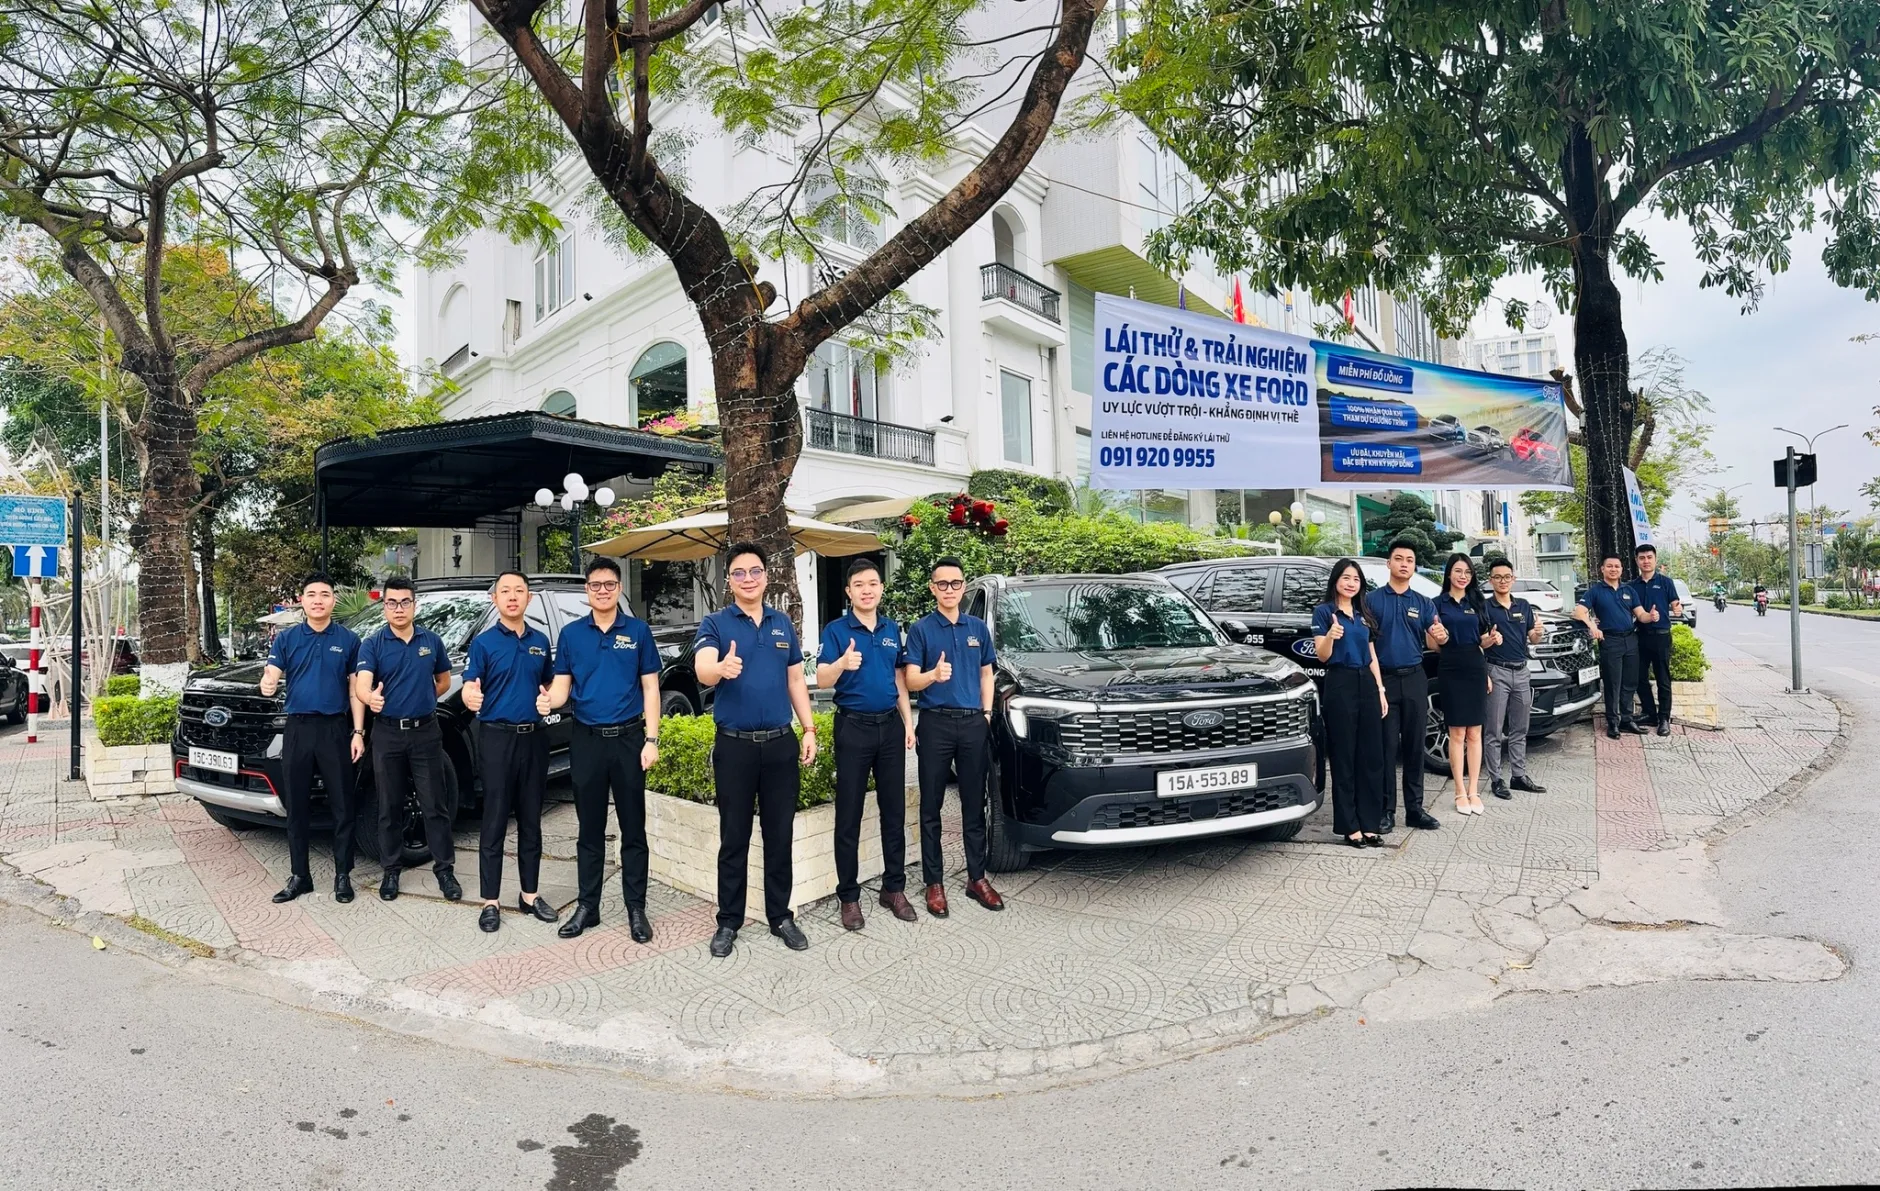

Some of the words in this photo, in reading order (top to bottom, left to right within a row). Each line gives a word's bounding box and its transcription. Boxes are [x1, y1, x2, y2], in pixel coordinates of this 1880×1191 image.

[1105, 323, 1137, 354] LÁI
[1140, 326, 1183, 358] THỬ
[1184, 337, 1199, 361] &
[1202, 334, 1242, 366] TRẢI
[1246, 346, 1307, 377] NGHIỆM
[1338, 362, 1358, 378] MIỄN
[1359, 368, 1372, 380] PHÍ
[1104, 355, 1150, 394] CÁC
[1155, 360, 1220, 398] DÒNG
[1224, 372, 1252, 402] XE
[1256, 376, 1308, 406] FORD
[1102, 401, 1119, 413] UY
[1121, 400, 1142, 417] LỰC
[1144, 401, 1175, 418] VƯỢT
[1177, 403, 1201, 419] TRỘI
[1209, 402, 1244, 420] KHẲNG
[1245, 409, 1269, 422] ĐỊNH
[1270, 411, 1280, 424] VỊ
[1342, 414, 1360, 422] THAM
[1101, 429, 1118, 439] LIÊN
[1119, 430, 1129, 441] HỆ
[1130, 431, 1162, 440] HOTLINE
[1163, 428, 1172, 441] ĐỂ
[1173, 431, 1193, 441] ĐĂNG
[1194, 432, 1203, 442] KÝ
[1204, 432, 1215, 442] LÁI
[1100, 446, 1132, 467] 091
[1136, 446, 1169, 467] 920
[1173, 447, 1215, 467] 9955
[771, 629, 784, 637] Ford
[329, 645, 343, 653] Ford
[613, 640, 637, 649] Ford
[882, 637, 898, 648] Ford
[1191, 713, 1216, 726] Ford
[194, 751, 233, 770] 15C-390.63
[1169, 769, 1248, 791] 15A-553.89
